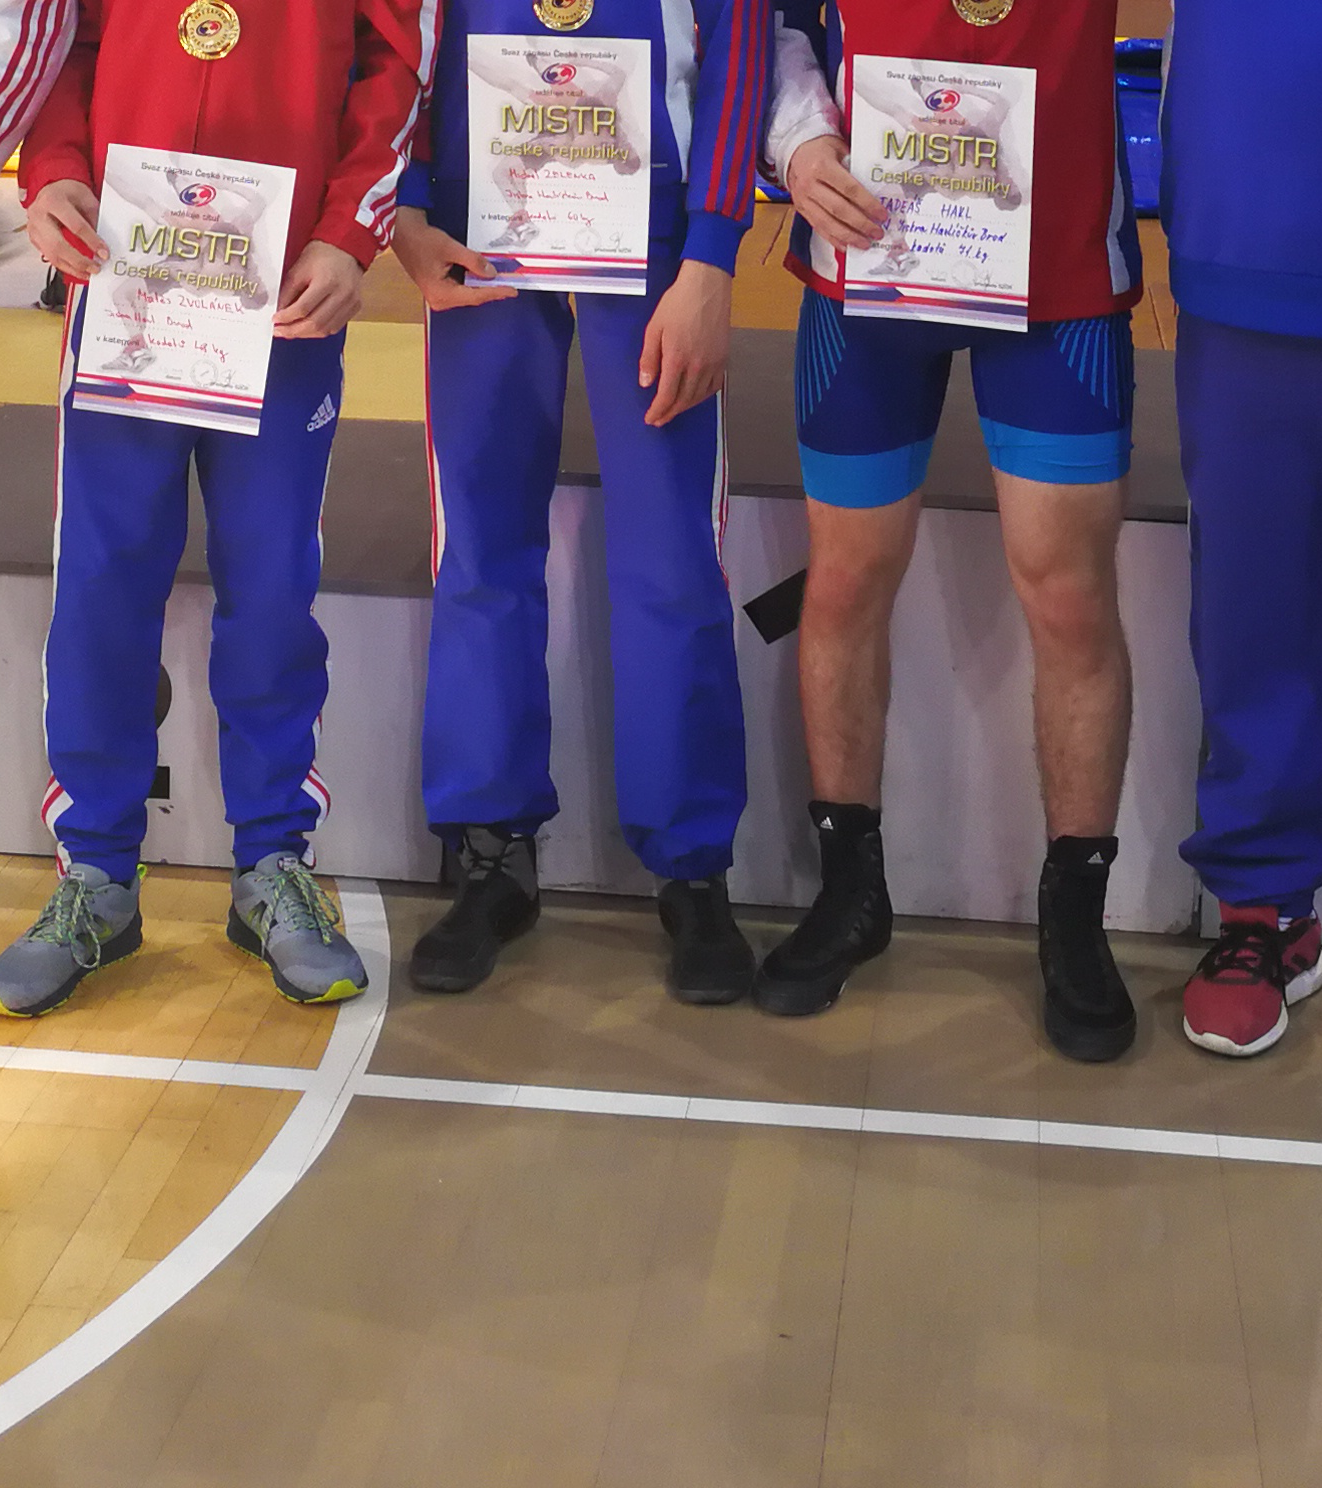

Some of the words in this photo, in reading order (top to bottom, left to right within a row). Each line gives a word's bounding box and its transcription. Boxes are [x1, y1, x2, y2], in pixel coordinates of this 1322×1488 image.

[501, 104, 617, 137] MISTR
[550, 143, 629, 164] republiky
[883, 129, 998, 169] MISTR
[930, 174, 1011, 199] republiky
[129, 223, 251, 268] MISTR
[176, 269, 259, 299] republiky
